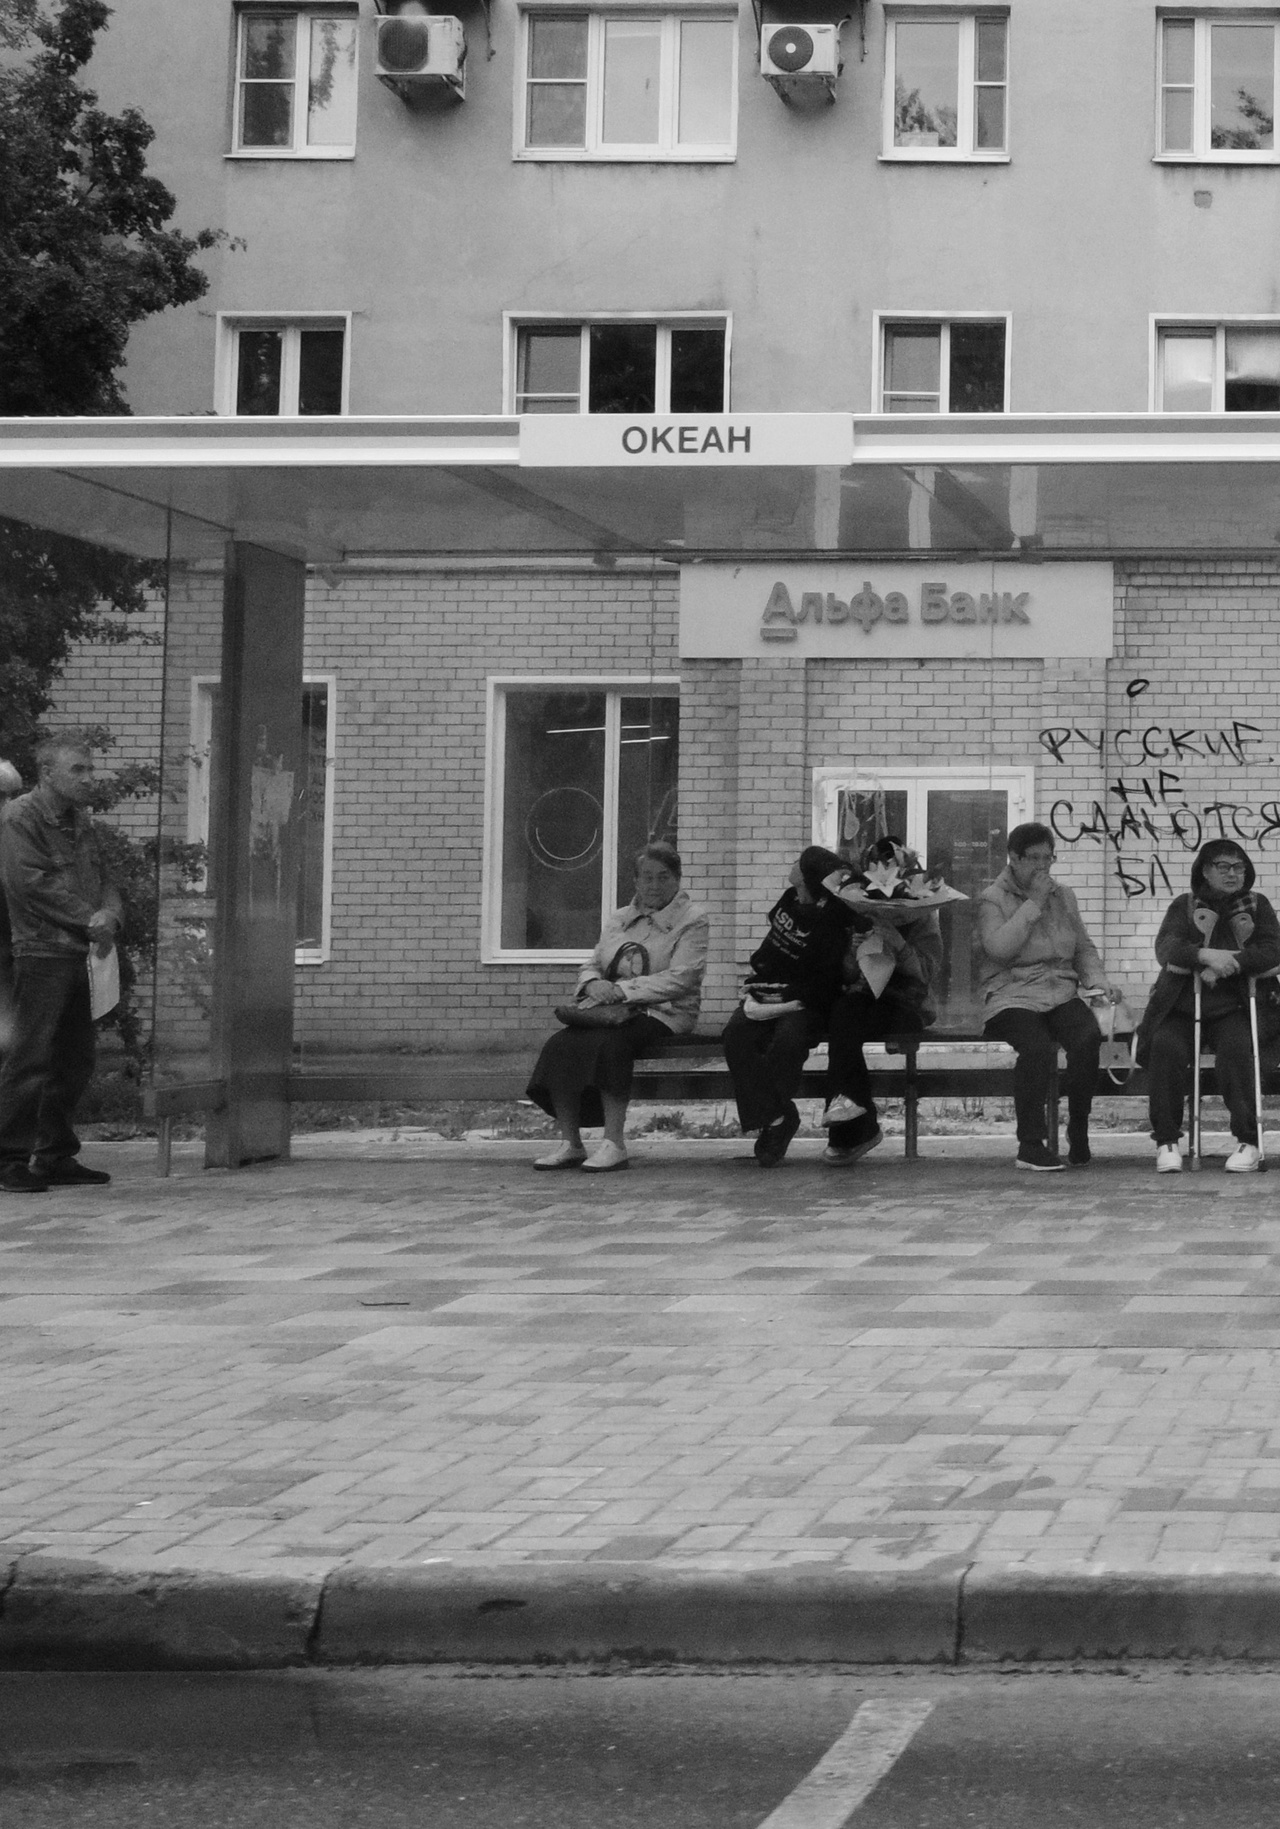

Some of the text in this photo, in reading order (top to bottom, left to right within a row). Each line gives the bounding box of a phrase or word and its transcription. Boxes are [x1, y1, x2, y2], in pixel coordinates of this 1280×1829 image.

[621, 425, 752, 455] ОКЕАН
[760, 581, 1032, 642] Альфа Банк
[1038, 721, 1274, 769] РУССКИЕ
[1109, 769, 1189, 808] НЕ
[774, 907, 794, 931] LSD
